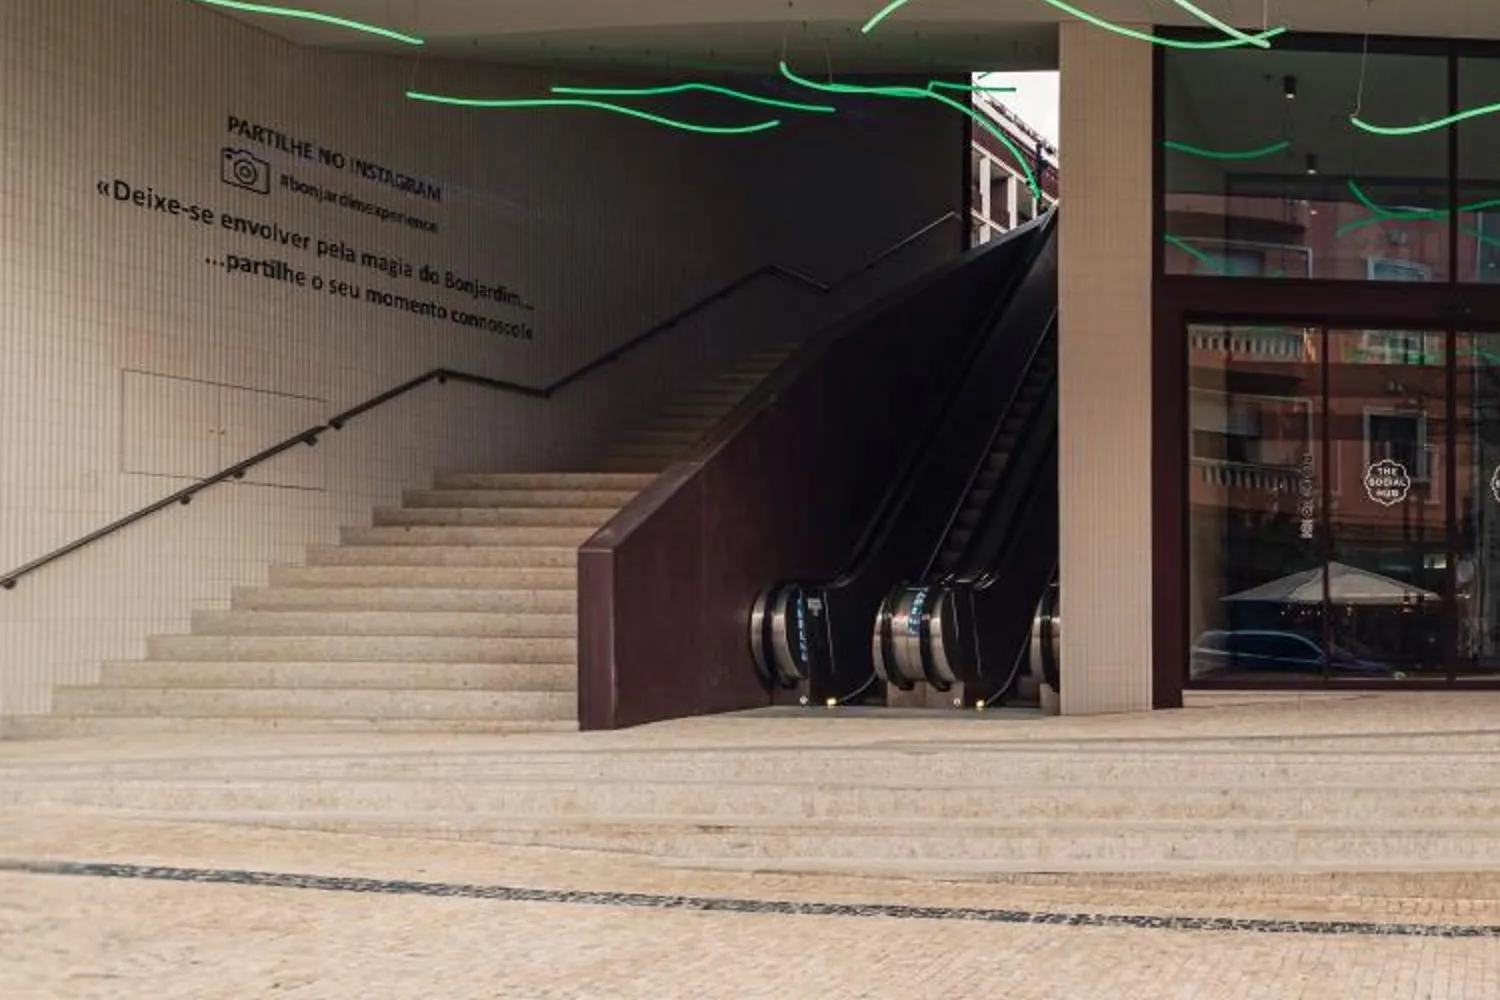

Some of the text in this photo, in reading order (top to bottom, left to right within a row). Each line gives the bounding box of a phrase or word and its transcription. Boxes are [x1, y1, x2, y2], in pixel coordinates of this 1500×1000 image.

[228, 115, 441, 202] PARTILHE NO INSTAGRAM
[220, 212, 311, 250] envolver
[317, 239, 356, 263] pela
[361, 251, 413, 278] magia
[418, 263, 440, 285] do
[311, 275, 323, 291] o
[328, 277, 361, 299] seu
[365, 286, 448, 320] momento
[1368, 478, 1407, 487] SOCIAL
[1377, 467, 1398, 476] THE
[1376, 489, 1399, 498] HUB
